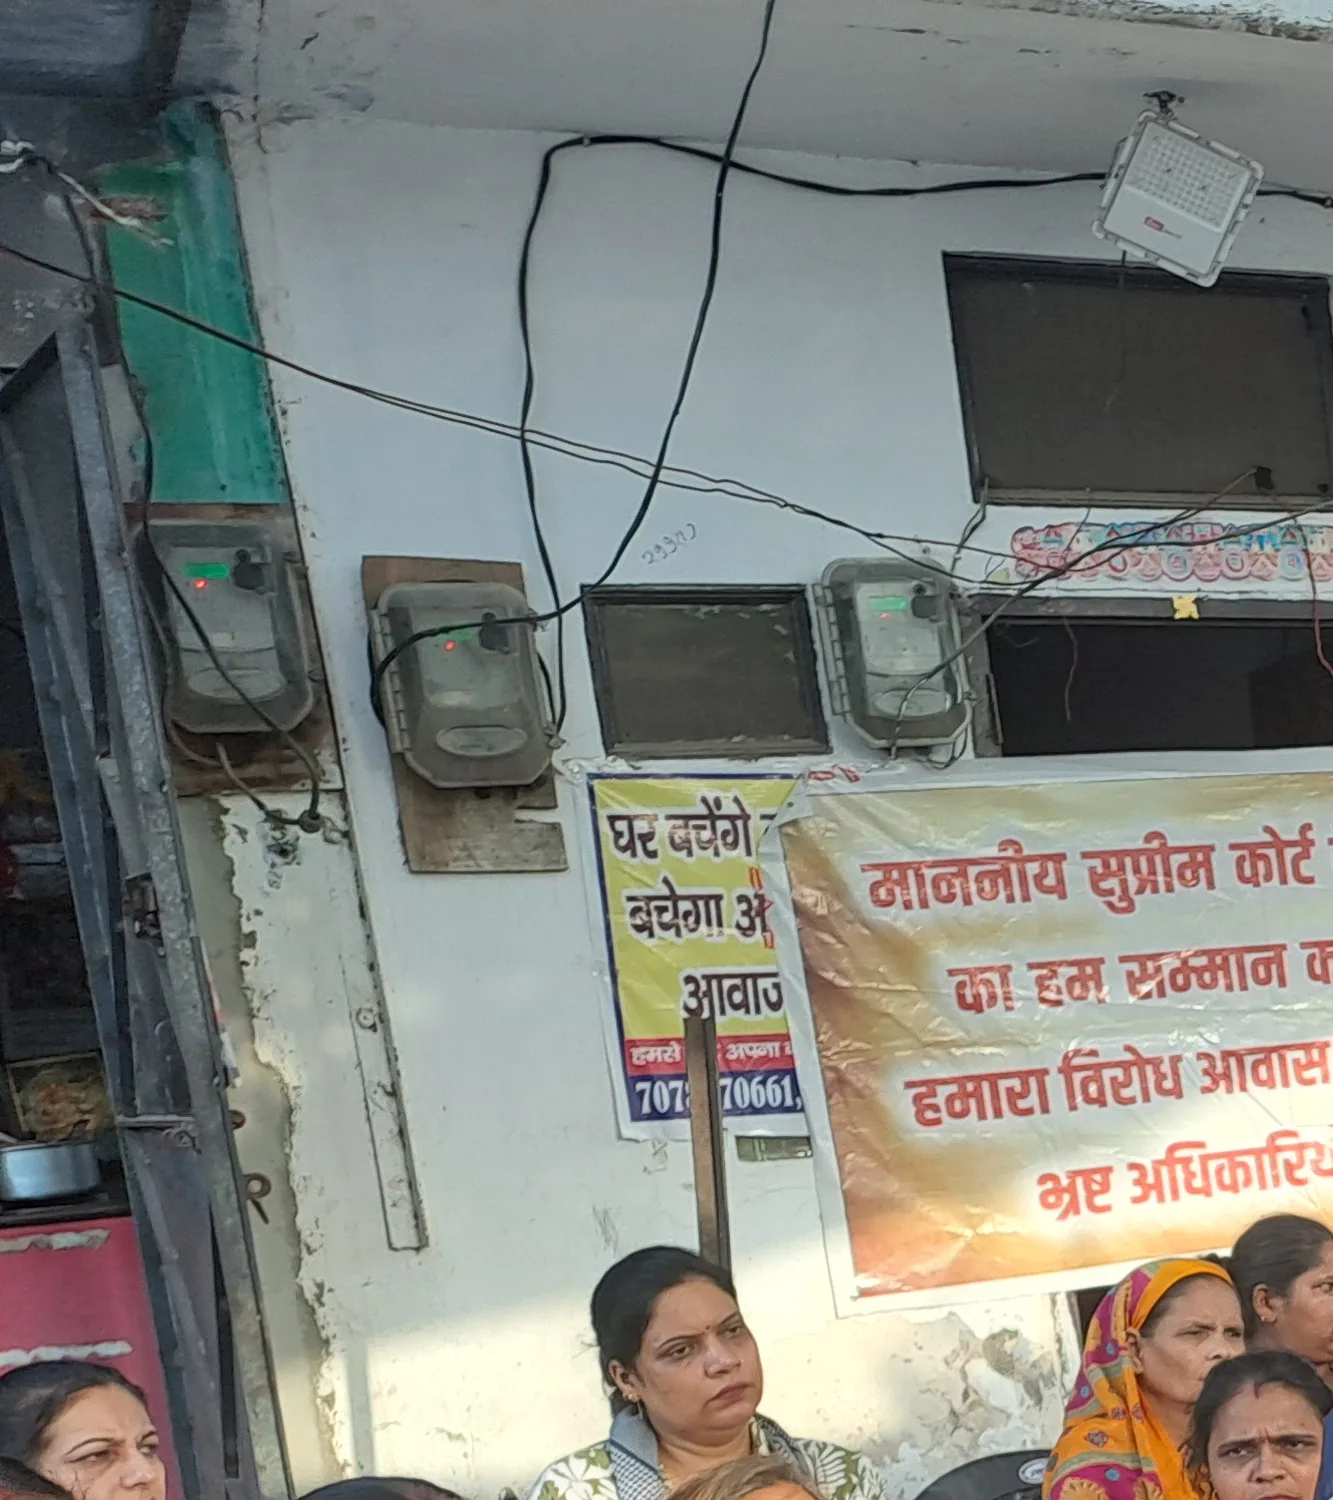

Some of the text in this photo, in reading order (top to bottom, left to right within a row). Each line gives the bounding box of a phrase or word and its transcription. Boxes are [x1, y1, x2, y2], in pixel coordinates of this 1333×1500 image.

[607, 814, 658, 858] घर
[665, 795, 752, 858] बचेंगे
[860, 838, 1067, 910] माननीय
[1081, 831, 1216, 915] सुप्रीम
[1229, 822, 1316, 888] कोर्ट
[626, 876, 723, 938] बचेगा
[947, 964, 1013, 1014] का
[1027, 957, 1106, 1008] हम
[1119, 943, 1287, 1000] सम्मान
[905, 1067, 1050, 1127] हमारा
[1058, 1043, 1182, 1111] विरोध
[1197, 1040, 1330, 1094] आवास
[1037, 1165, 1114, 1221] भ्रष्ट
